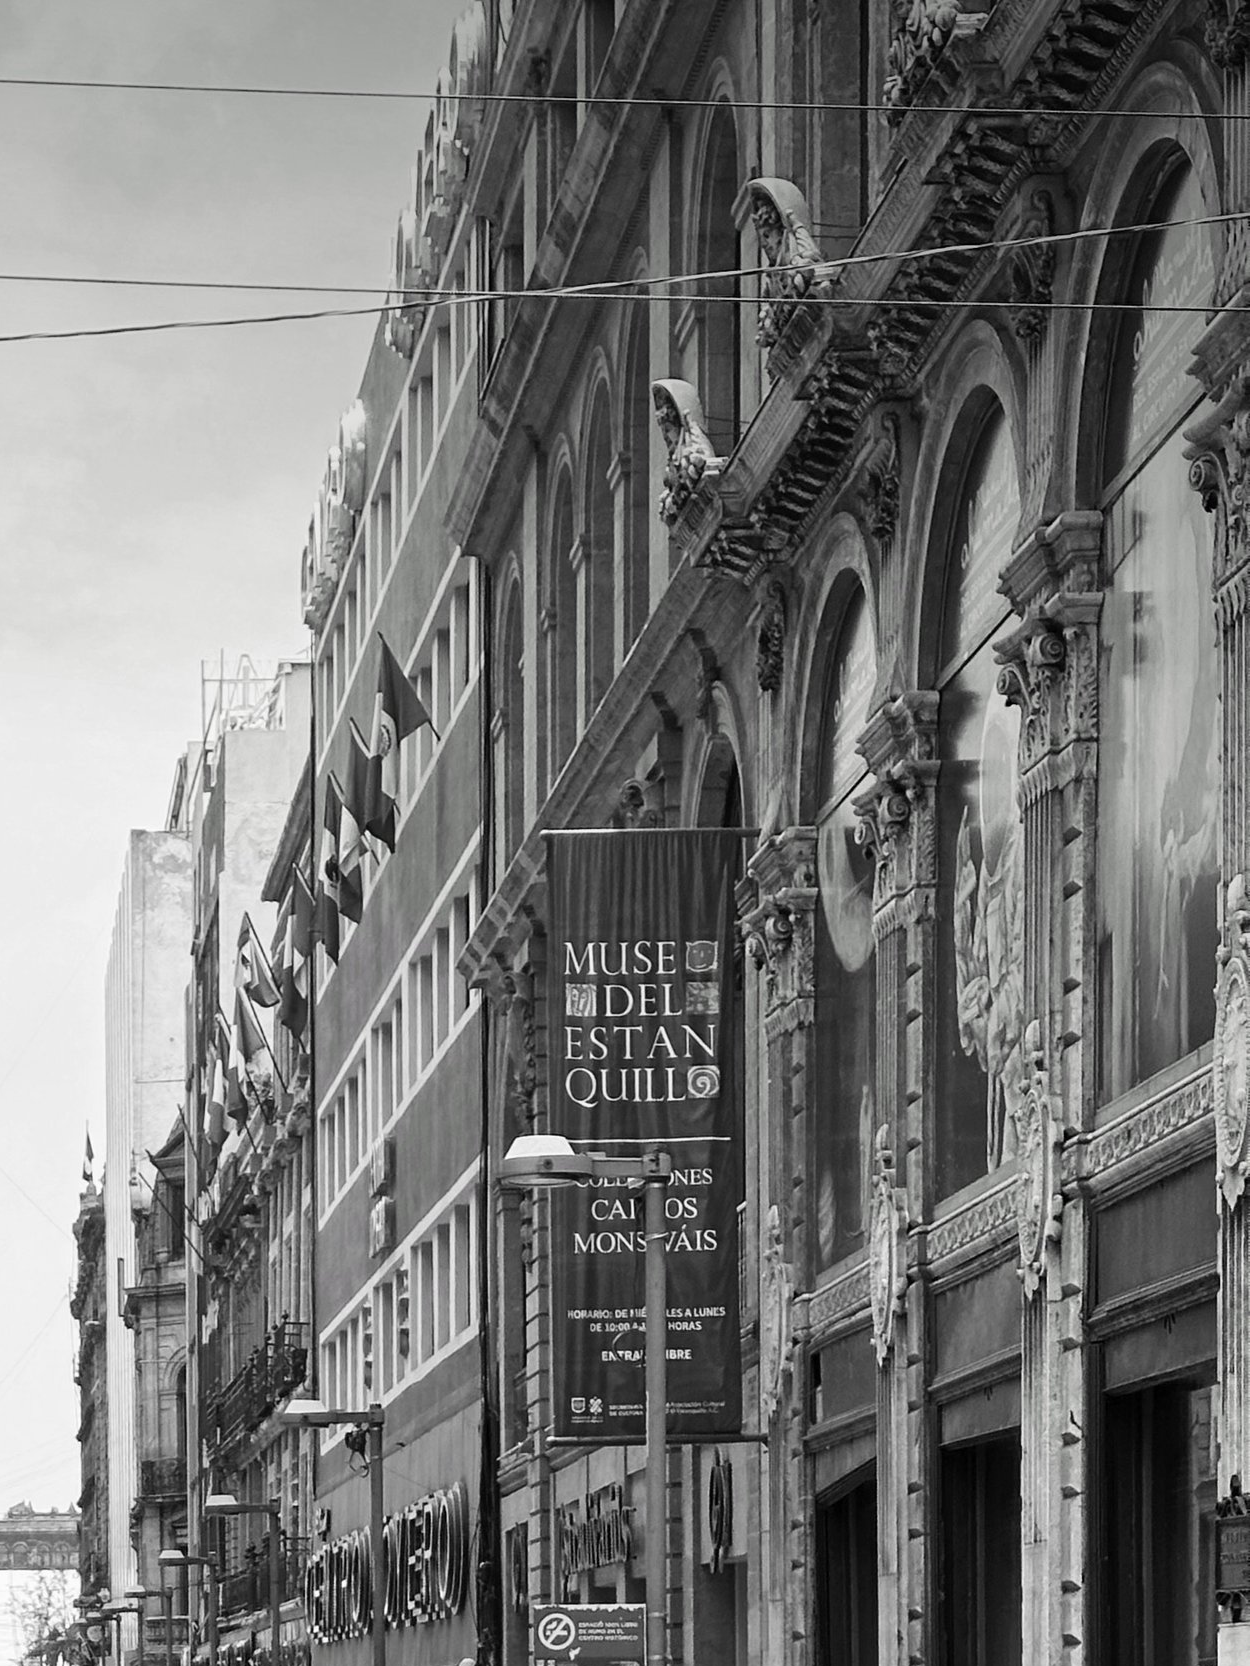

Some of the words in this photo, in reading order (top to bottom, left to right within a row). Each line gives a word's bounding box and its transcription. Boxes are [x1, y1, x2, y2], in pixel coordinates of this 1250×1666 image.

[603, 983, 683, 1017] DEL
[564, 1024, 716, 1060] ESTAN
[591, 1198, 698, 1221] CAOS
[574, 1224, 718, 1254] MONSVÁIS
[615, 1309, 628, 1318] DE
[684, 1307, 692, 1317] A
[693, 1306, 726, 1318] LUNES
[590, 1322, 602, 1332] DE
[667, 1320, 702, 1331] HORAS
[601, 1349, 647, 1362] ENTRA
[665, 1349, 693, 1360] IBRE
